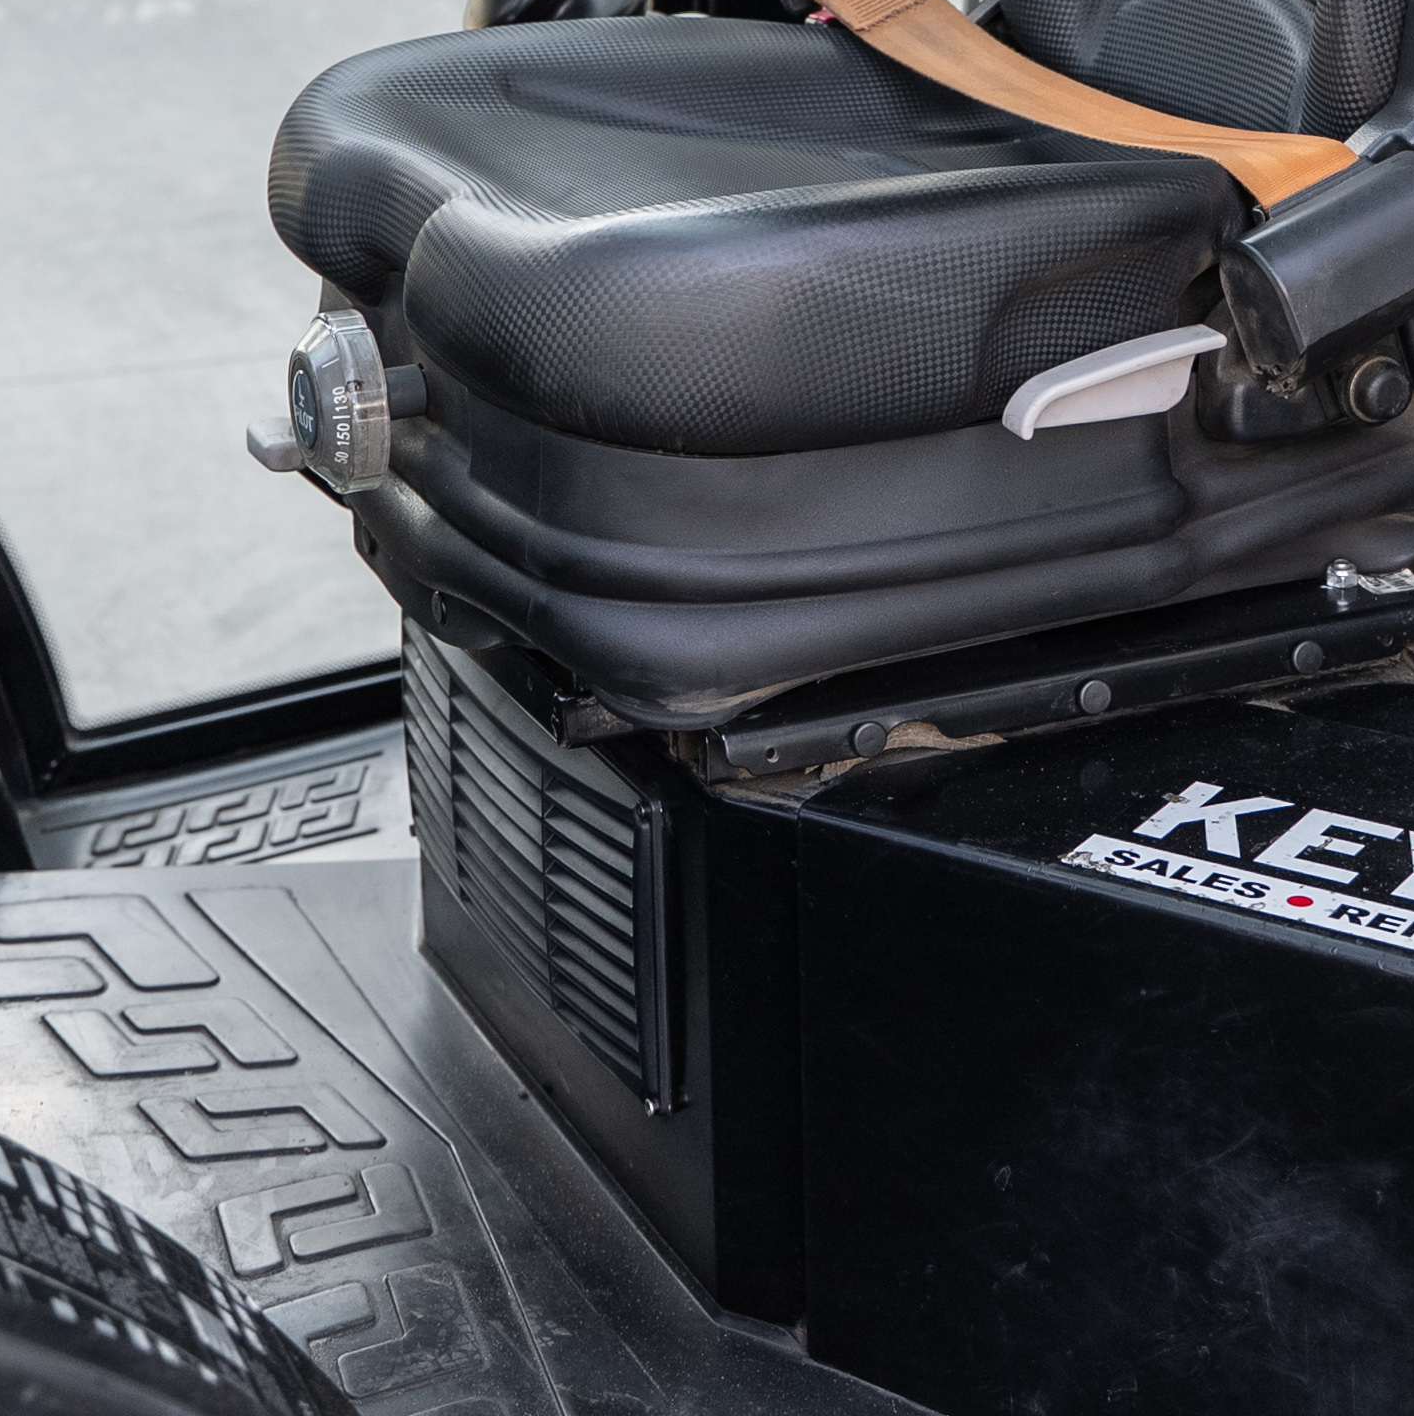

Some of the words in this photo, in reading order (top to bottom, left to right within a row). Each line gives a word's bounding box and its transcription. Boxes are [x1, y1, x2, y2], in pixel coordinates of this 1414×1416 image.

[332, 385, 349, 412] 130
[336, 422, 351, 448] 150
[334, 450, 349, 466] 50
[1104, 848, 1271, 900] SALES
